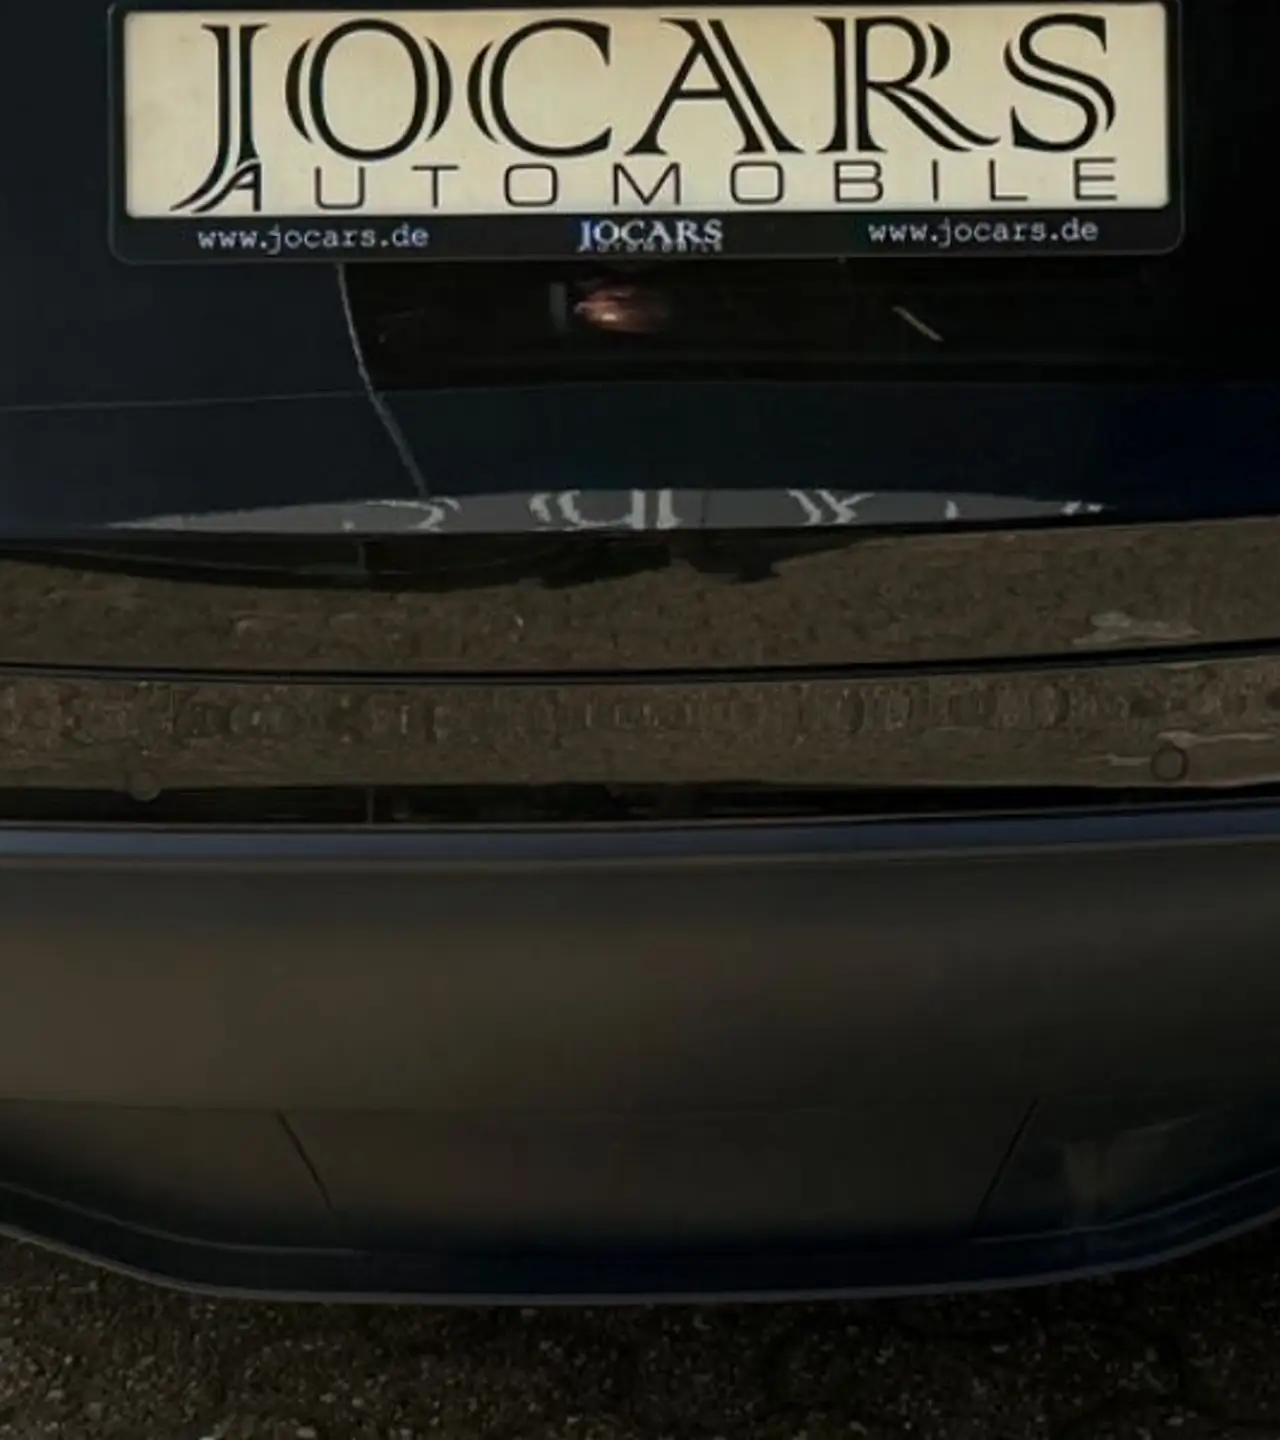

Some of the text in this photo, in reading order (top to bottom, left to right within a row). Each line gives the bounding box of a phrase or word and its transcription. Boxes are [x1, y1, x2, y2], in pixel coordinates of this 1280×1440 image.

[171, 12, 1117, 211] JOCARS
[194, 155, 1117, 212] AUTOMOBILE
[197, 223, 430, 256] www.jocars.de
[578, 217, 724, 249] JOCARS
[867, 216, 1099, 250] www.jocars.de
